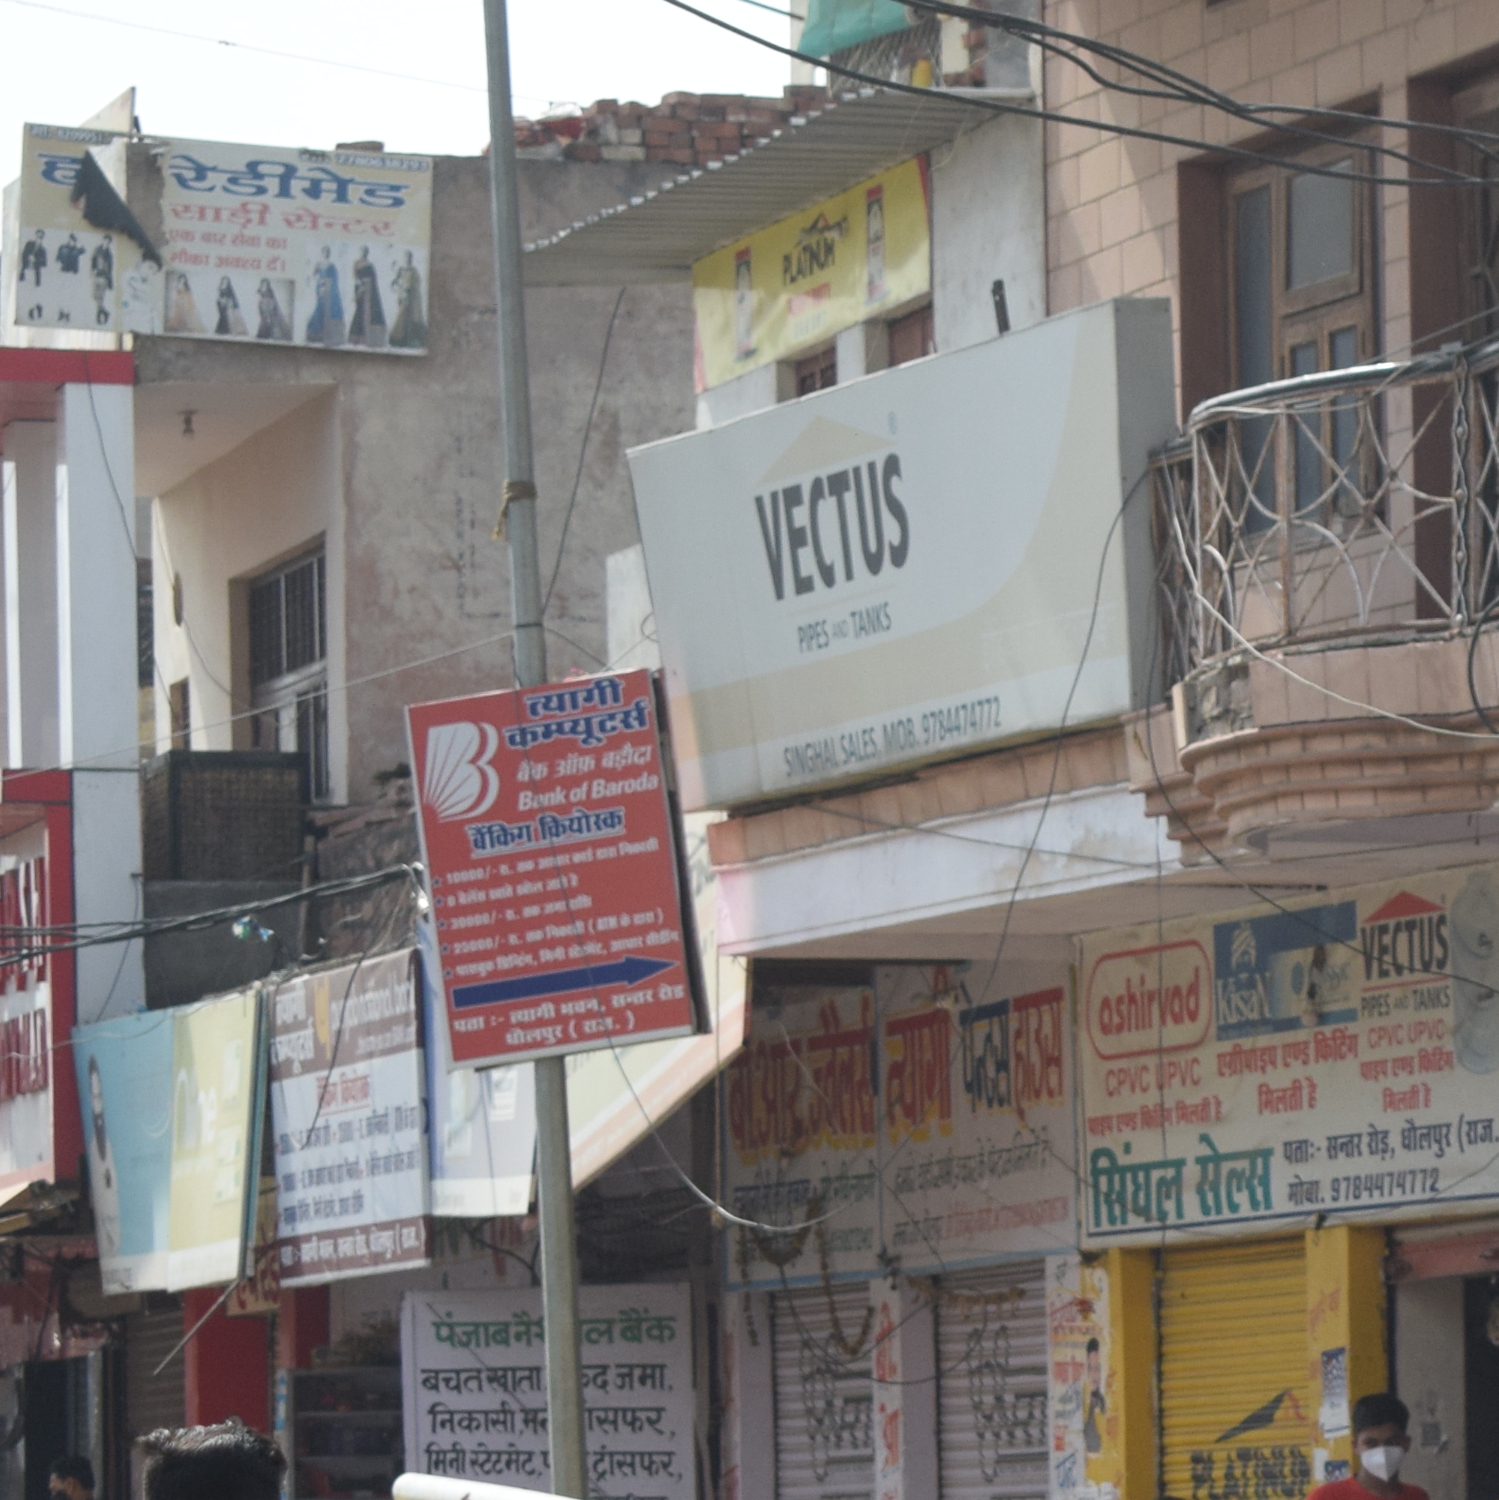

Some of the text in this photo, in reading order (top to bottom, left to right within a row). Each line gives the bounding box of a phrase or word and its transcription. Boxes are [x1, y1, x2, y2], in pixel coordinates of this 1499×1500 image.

[169, 154, 411, 210] रेडीमेड
[755, 452, 912, 603] VECTUS
[797, 619, 831, 653] PIPES
[849, 601, 893, 640] TANKS
[518, 772, 660, 811] Bank of Baroda
[1360, 913, 1450, 981] VECTUS
[1099, 964, 1200, 1037] ashirvad
[1360, 994, 1391, 1018] PIPES
[1411, 984, 1451, 1012] TANKS
[1367, 1023, 1405, 1050] CPVC
[1104, 1064, 1150, 1098] CPVC
[1089, 1141, 1188, 1230] सिंघल
[1194, 1132, 1275, 1217] सेल्स
[1331, 1167, 1439, 1202] 9784474772
[431, 1310, 511, 1349] पंजाब
[618, 1307, 677, 1344] बैंक
[420, 1367, 484, 1394] बचत
[425, 1441, 467, 1474] मिनी
